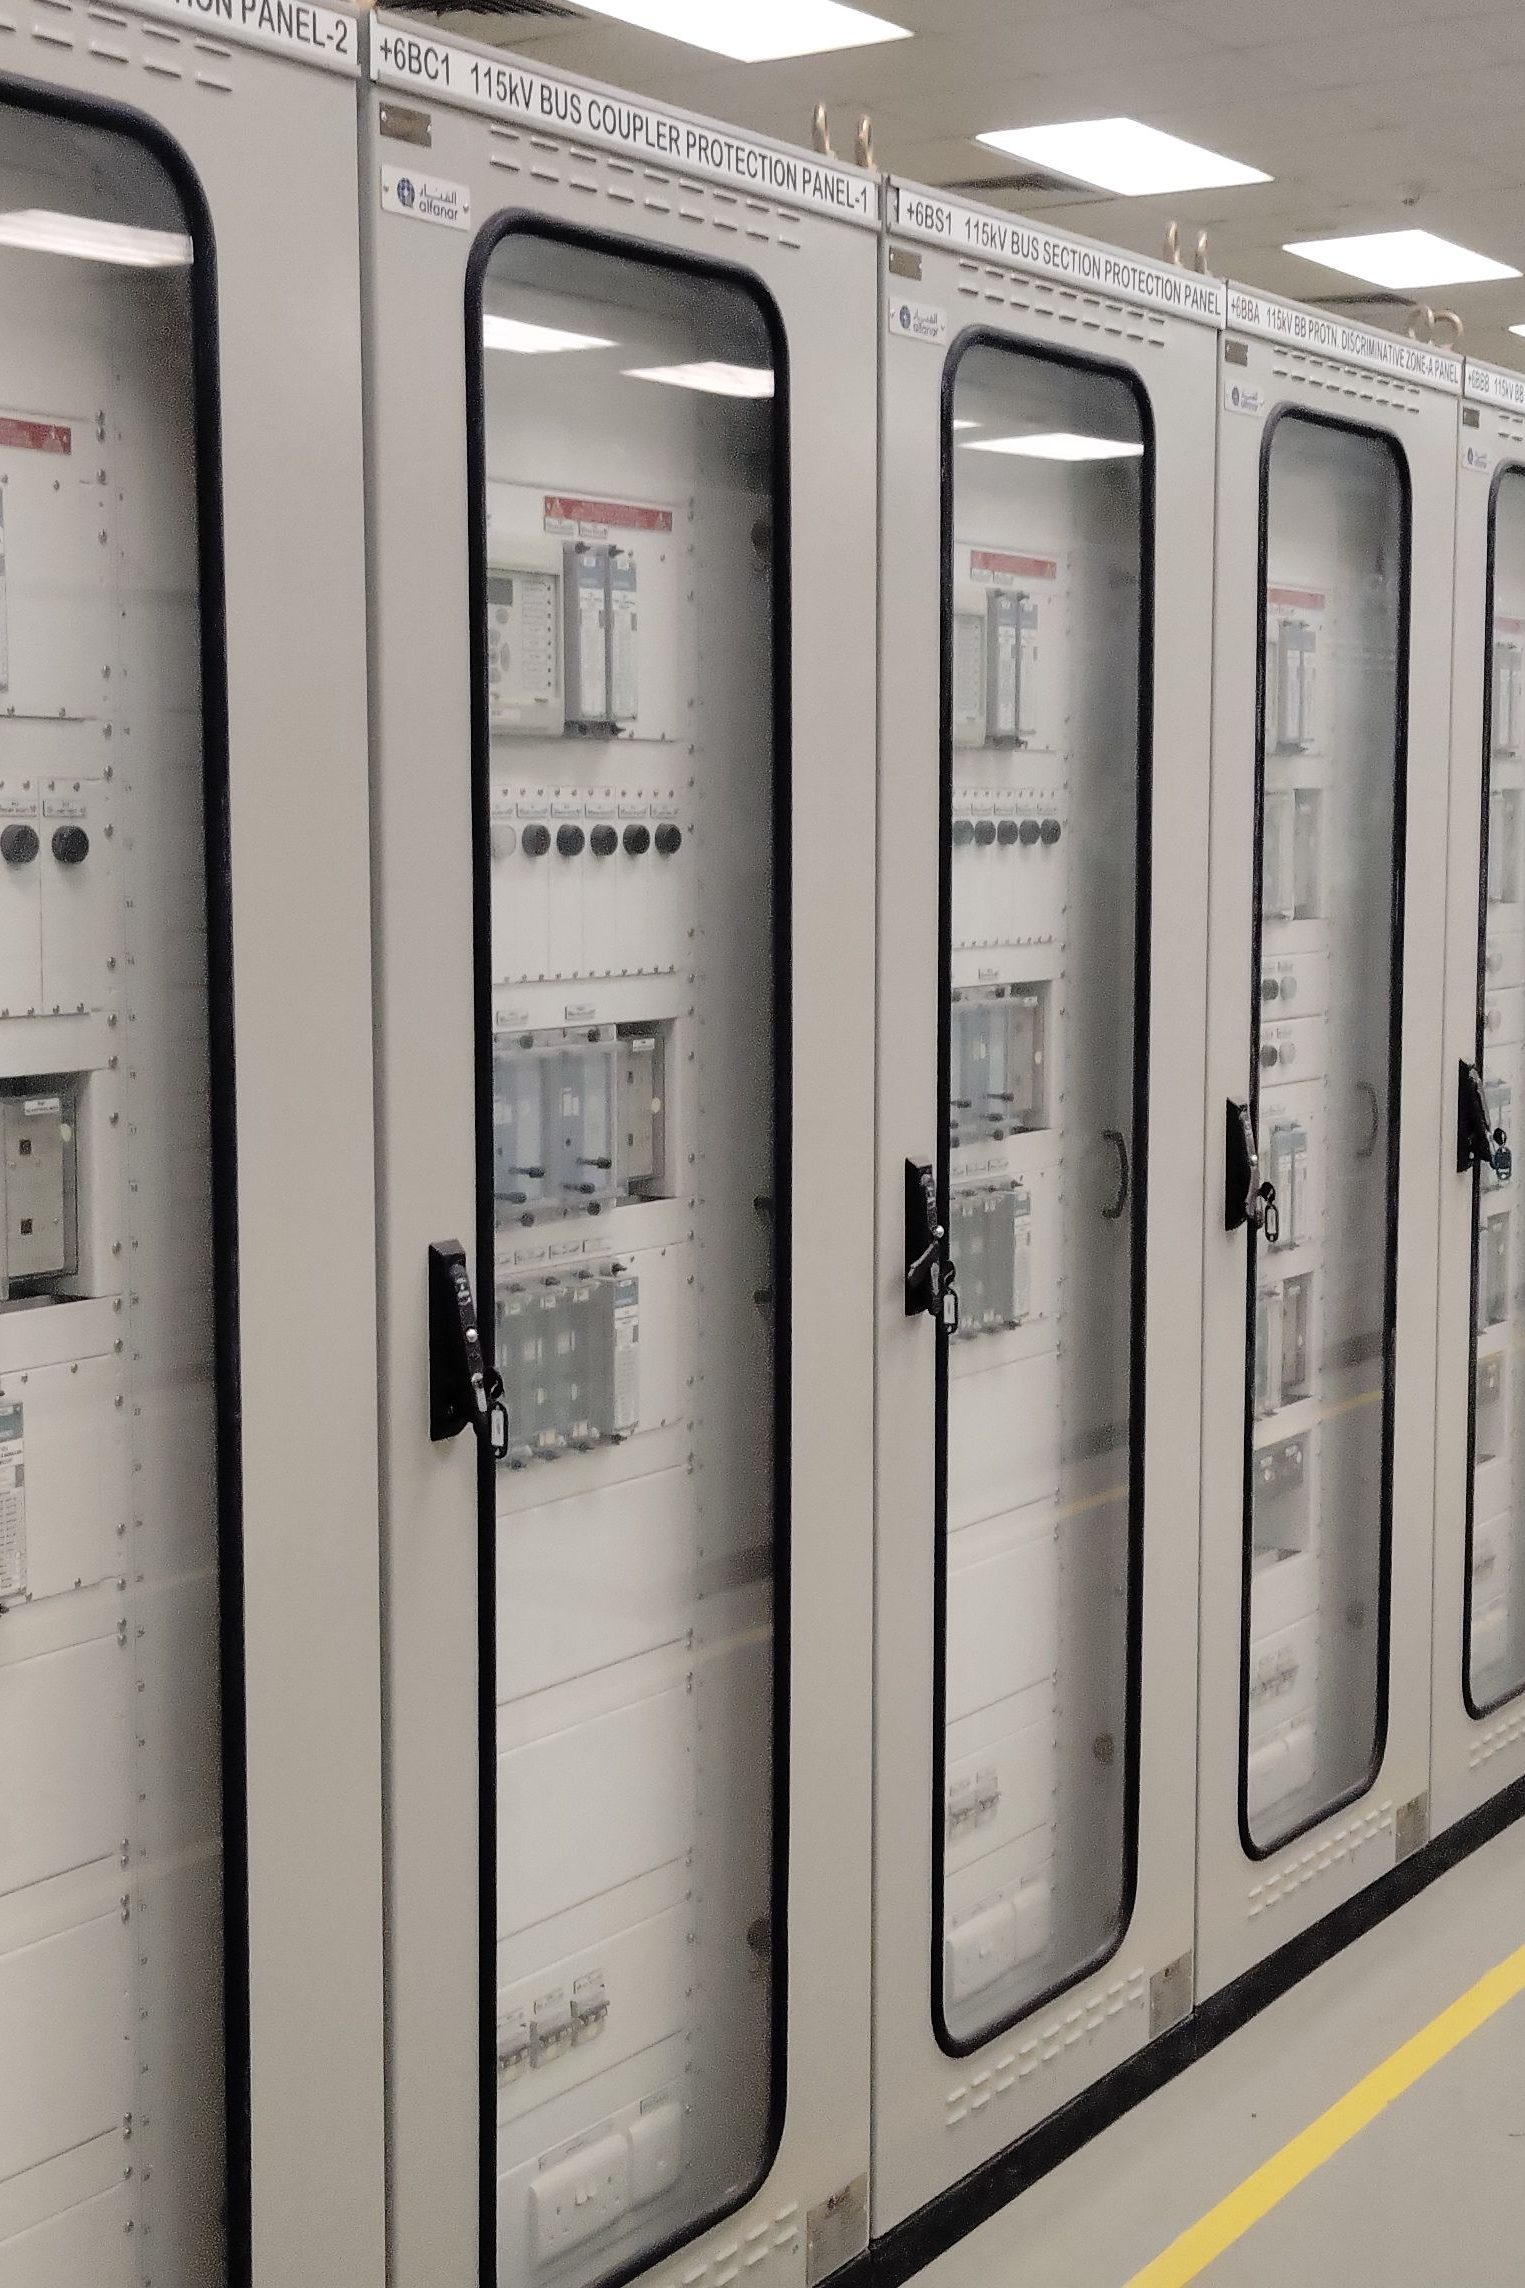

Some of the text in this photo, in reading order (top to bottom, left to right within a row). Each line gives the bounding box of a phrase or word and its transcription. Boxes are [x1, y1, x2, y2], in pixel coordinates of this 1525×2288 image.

[241, 0, 348, 54] PANEL-2
[379, 37, 868, 213] +6BC1 115kV BUS COUPLER PROTECTION PANEL-1
[418, 199, 458, 220] alfanar
[907, 202, 1222, 317] +6BS1 115kV BUS SECTION PROTECTION PANEL
[1267, 306, 1293, 334] 115kV
[1294, 315, 1306, 338] BB
[1341, 330, 1405, 368] DISCRIMINATIVE
[1405, 349, 1434, 377] ZONE-A
[1434, 359, 1459, 384] PANEL
